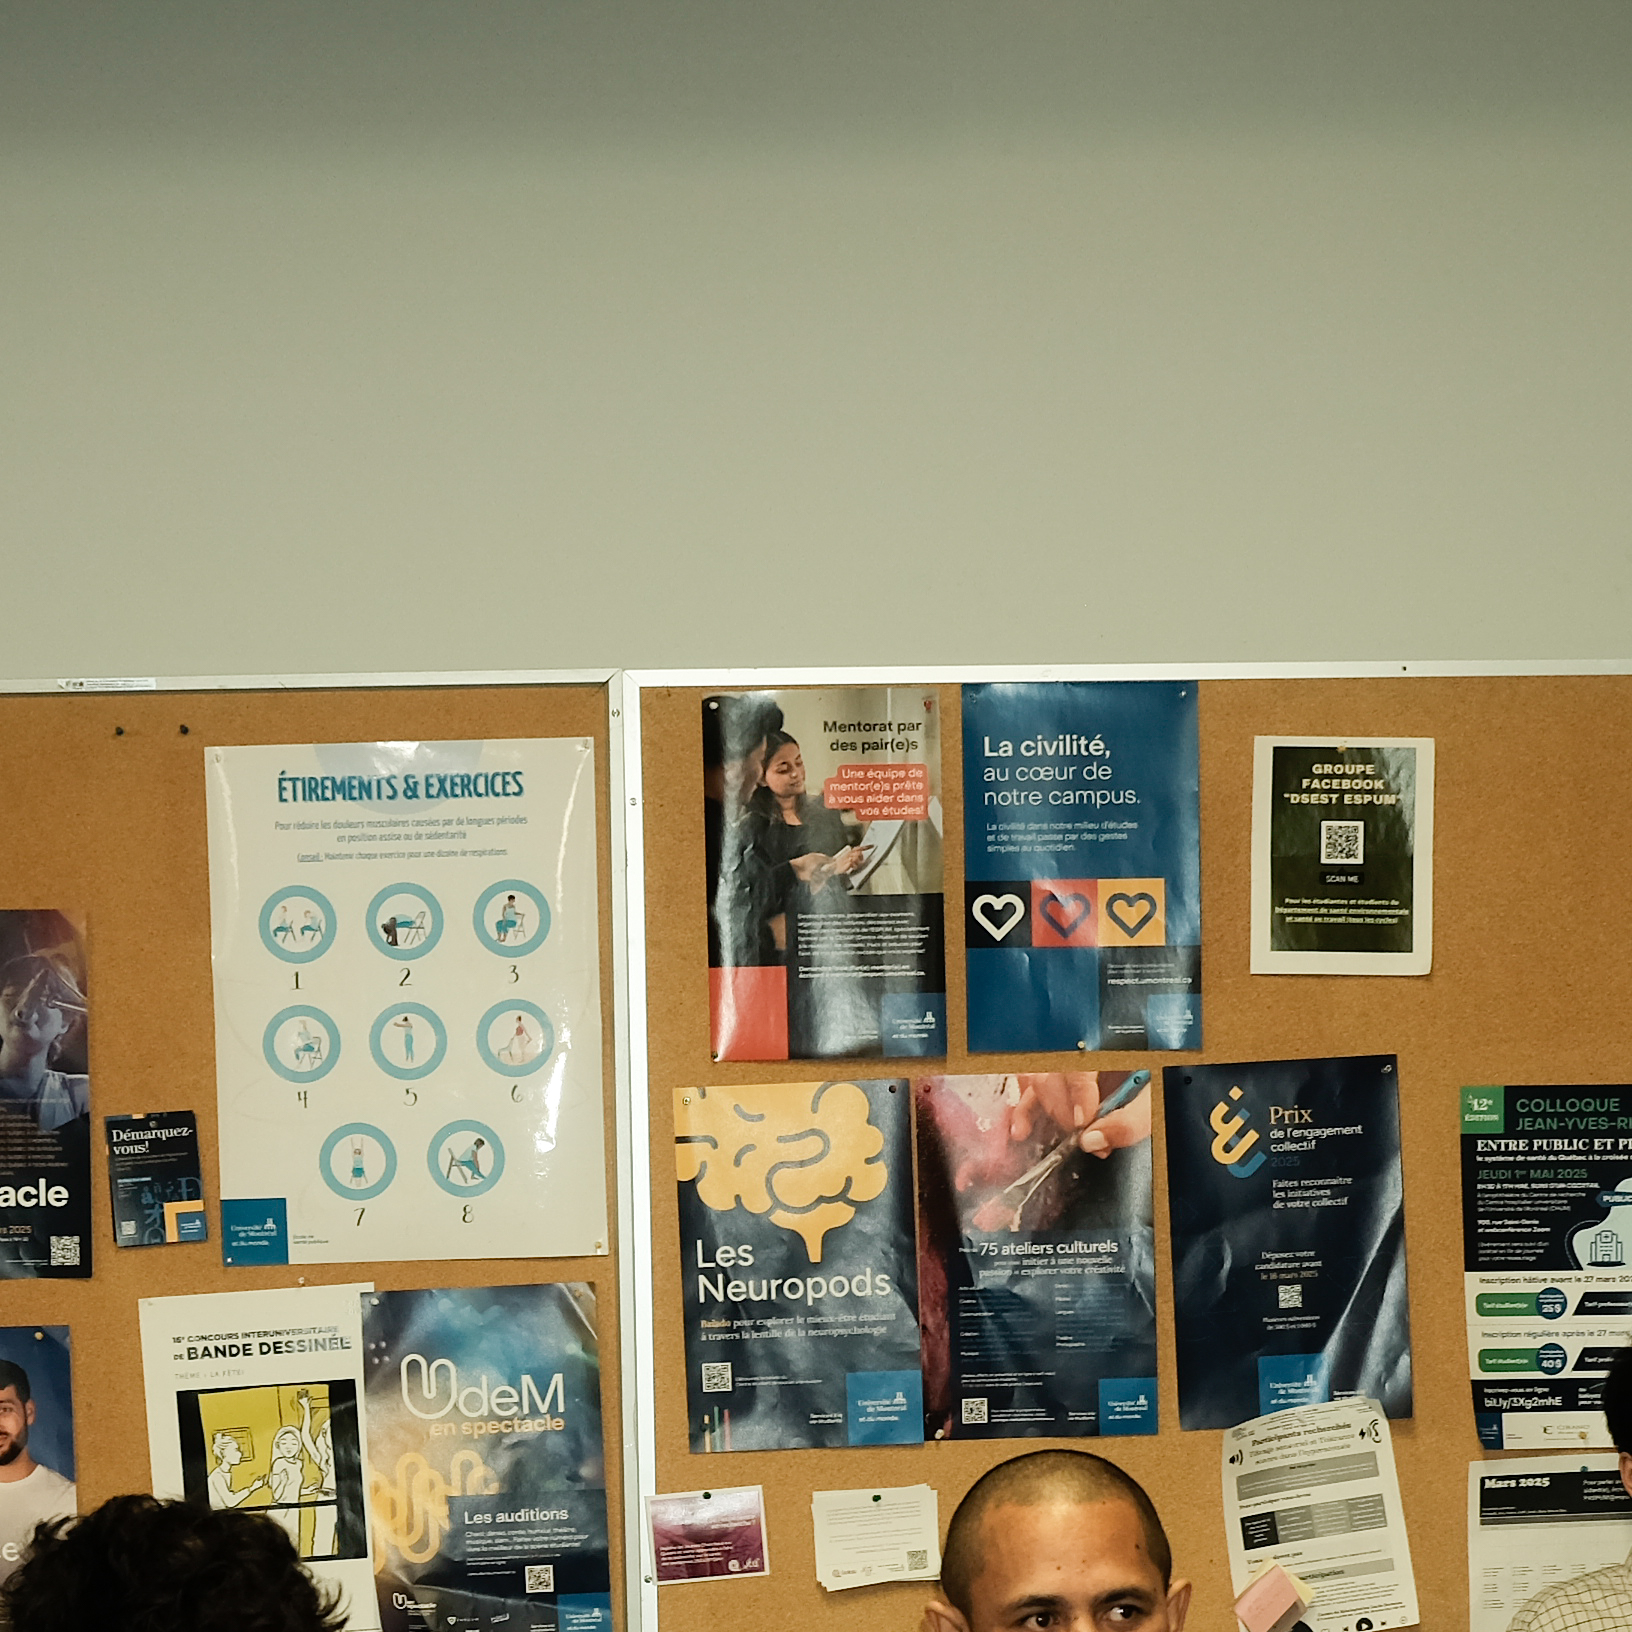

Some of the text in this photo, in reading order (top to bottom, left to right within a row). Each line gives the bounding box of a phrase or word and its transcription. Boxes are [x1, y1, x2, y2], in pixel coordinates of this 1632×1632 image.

[823, 721, 922, 735] Mentorat par
[830, 738, 918, 754] des pair(e)s
[983, 734, 1111, 759] La civilité,
[842, 769, 923, 780] Une équipe de
[983, 761, 1112, 781] au cœur de
[1312, 764, 1375, 774] GROUPE
[278, 770, 524, 803] ÉTIREMENTS & EXERCICES
[830, 782, 890, 793] mentor(e)s
[1302, 779, 1384, 789] FACEBOOK
[829, 793, 923, 804] à vous aider dans
[984, 789, 1140, 809] notre campus.
[882, 806, 924, 815] études!
[291, 972, 303, 990] 1
[398, 968, 413, 987] 2
[508, 965, 519, 984] 3
[297, 1091, 308, 1108] 4
[403, 1088, 417, 1106] 5
[510, 1085, 523, 1103] 6
[1516, 1098, 1620, 1113] COLLOQUE
[1269, 1105, 1313, 1125] Prix
[112, 1127, 193, 1143] Démarquez-
[1270, 1125, 1363, 1140] de l'engagement
[113, 1141, 149, 1155] vous!
[1271, 1139, 1316, 1153] collectif
[1476, 1139, 1529, 1151] ENTRE
[1532, 1139, 1589, 1151] PUBLIC
[1594, 1139, 1614, 1149] ET
[1477, 1169, 1511, 1180] JEUDI
[1530, 1169, 1554, 1179] MAI
[1558, 1169, 1588, 1179] 2025
[353, 1207, 365, 1227] 7
[462, 1205, 474, 1224] 8
[696, 1239, 755, 1268] Les
[979, 1240, 1119, 1256] 75 ateliers culturels
[698, 1267, 891, 1306] Neuropods
[188, 1325, 339, 1343] CONCOURS INTERUNIVERSITAIRE
[187, 1343, 253, 1360] BANDE
[259, 1334, 352, 1355] DESSINÉE
[400, 1353, 565, 1420] UdeM
[430, 1414, 565, 1438] en spectacle
[1484, 1477, 1550, 1489] Mars 2025
[464, 1507, 569, 1525] Les auditions
